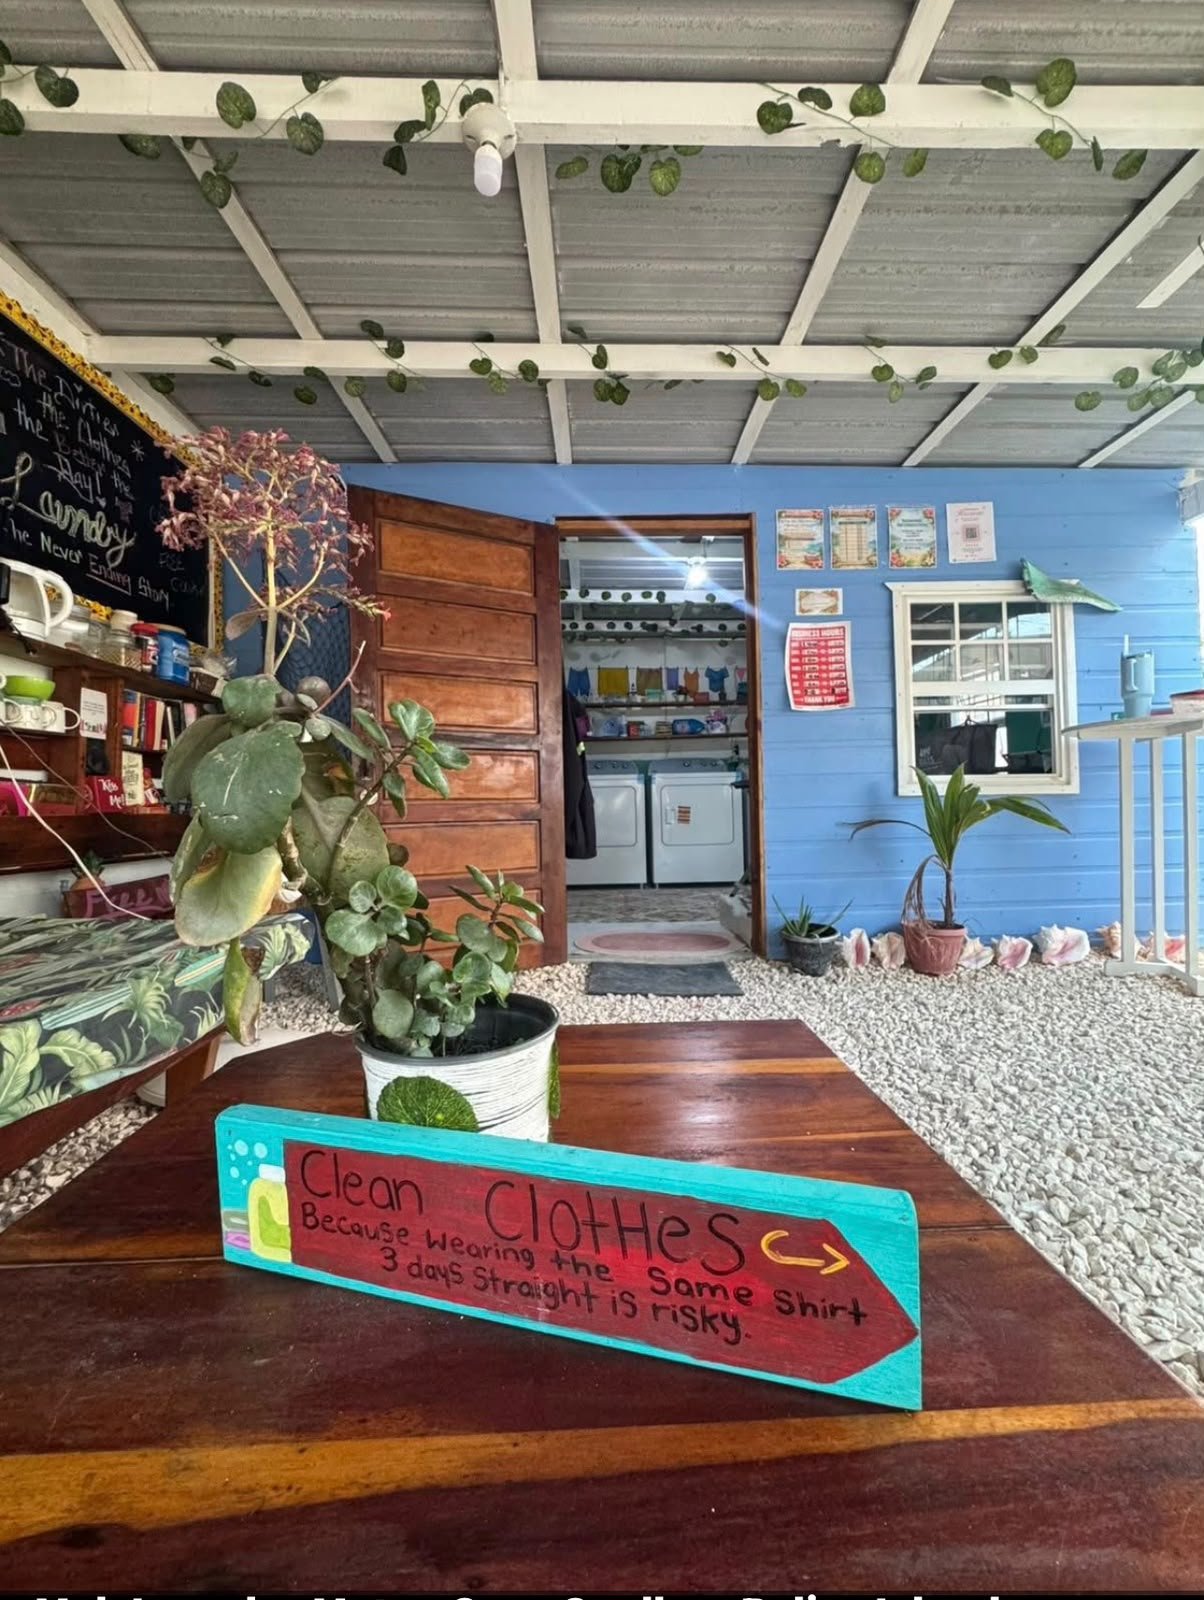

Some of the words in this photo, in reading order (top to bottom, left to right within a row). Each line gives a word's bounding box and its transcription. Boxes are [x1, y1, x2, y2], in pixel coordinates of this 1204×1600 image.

[13, 398, 48, 441] the
[40, 532, 83, 563] Never
[88, 553, 131, 586] Ending
[138, 576, 169, 612] Story
[301, 1150, 423, 1215] Clean
[302, 1202, 410, 1246] Because
[551, 1251, 614, 1283] the
[379, 1246, 398, 1272] 3
